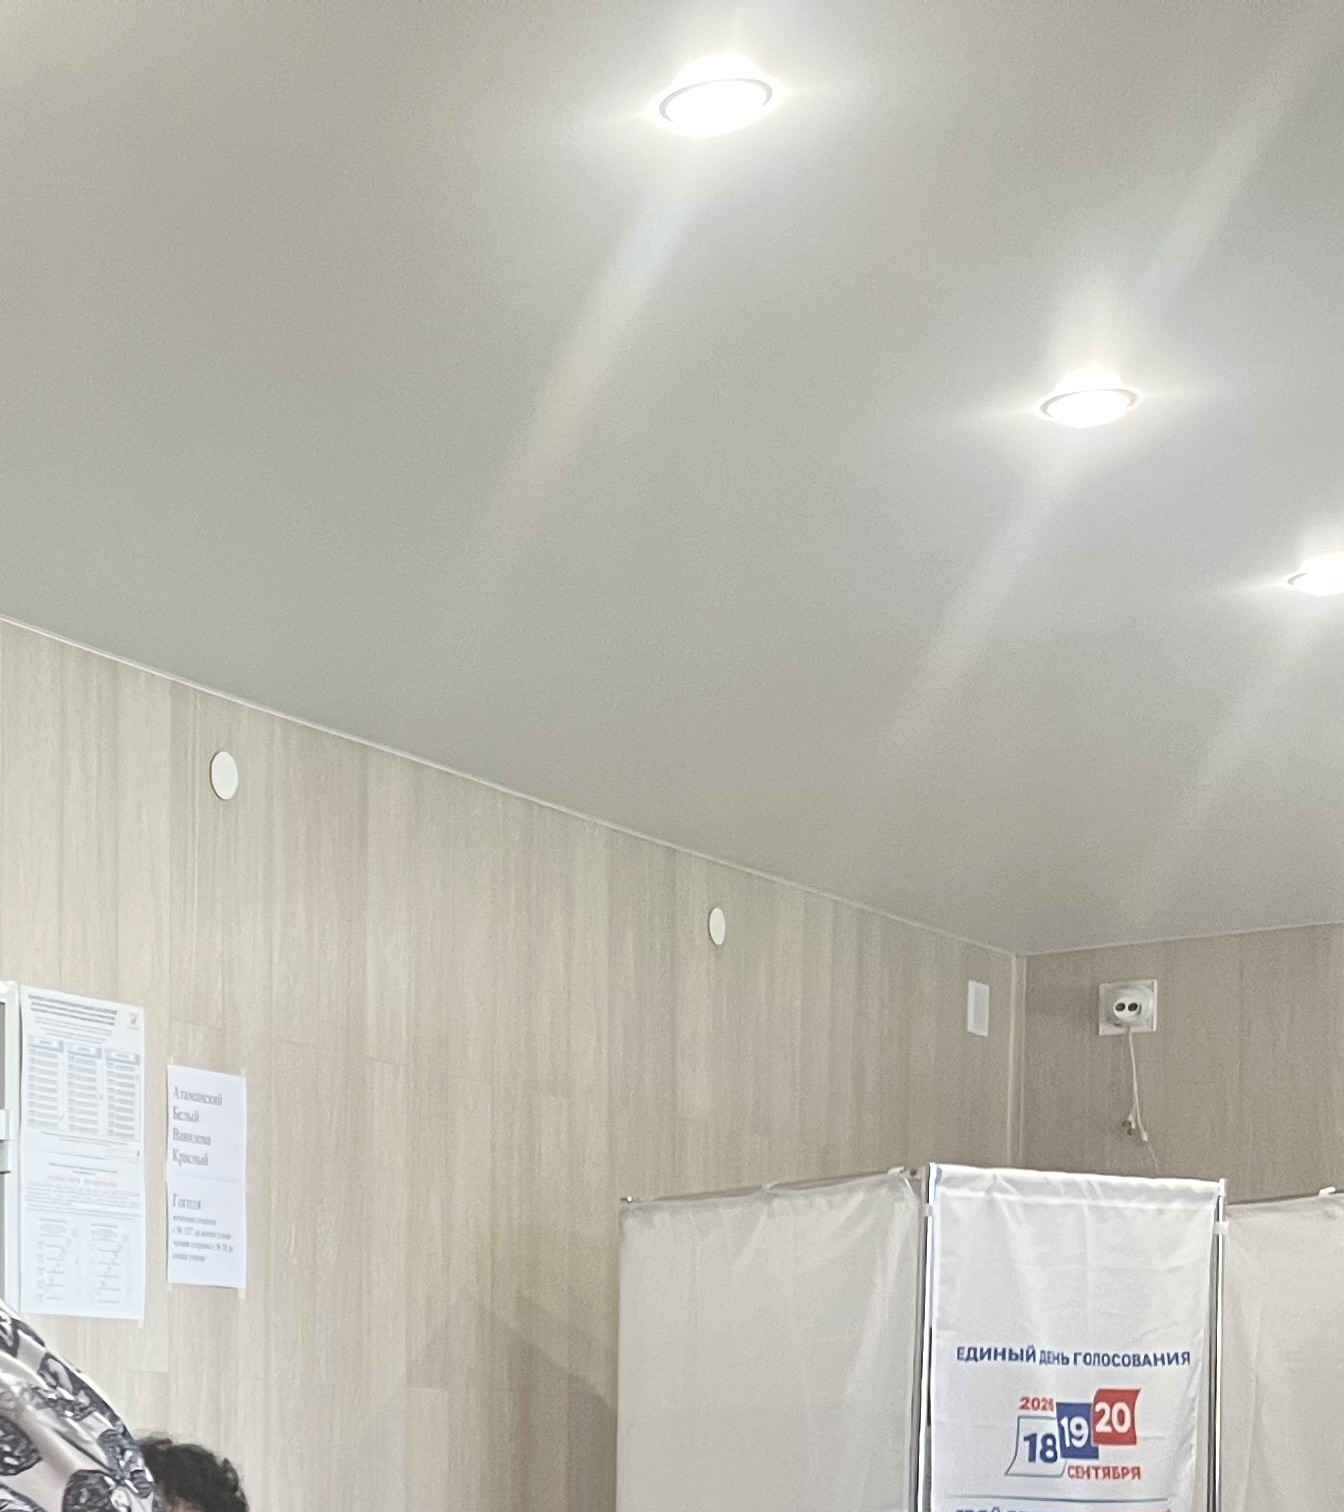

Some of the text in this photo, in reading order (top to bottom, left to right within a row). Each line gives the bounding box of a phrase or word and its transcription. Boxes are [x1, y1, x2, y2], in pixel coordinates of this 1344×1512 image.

[956, 1345, 1191, 1368] ЕДИНЫЙ ДЕНЬ ГОЛОСОВАНИЯ
[1060, 1416, 1089, 1448] 19
[1095, 1402, 1131, 1433] 20
[1023, 1433, 1058, 1463] 18
[1067, 1466, 1141, 1480] СЕНТЯБРЯ
